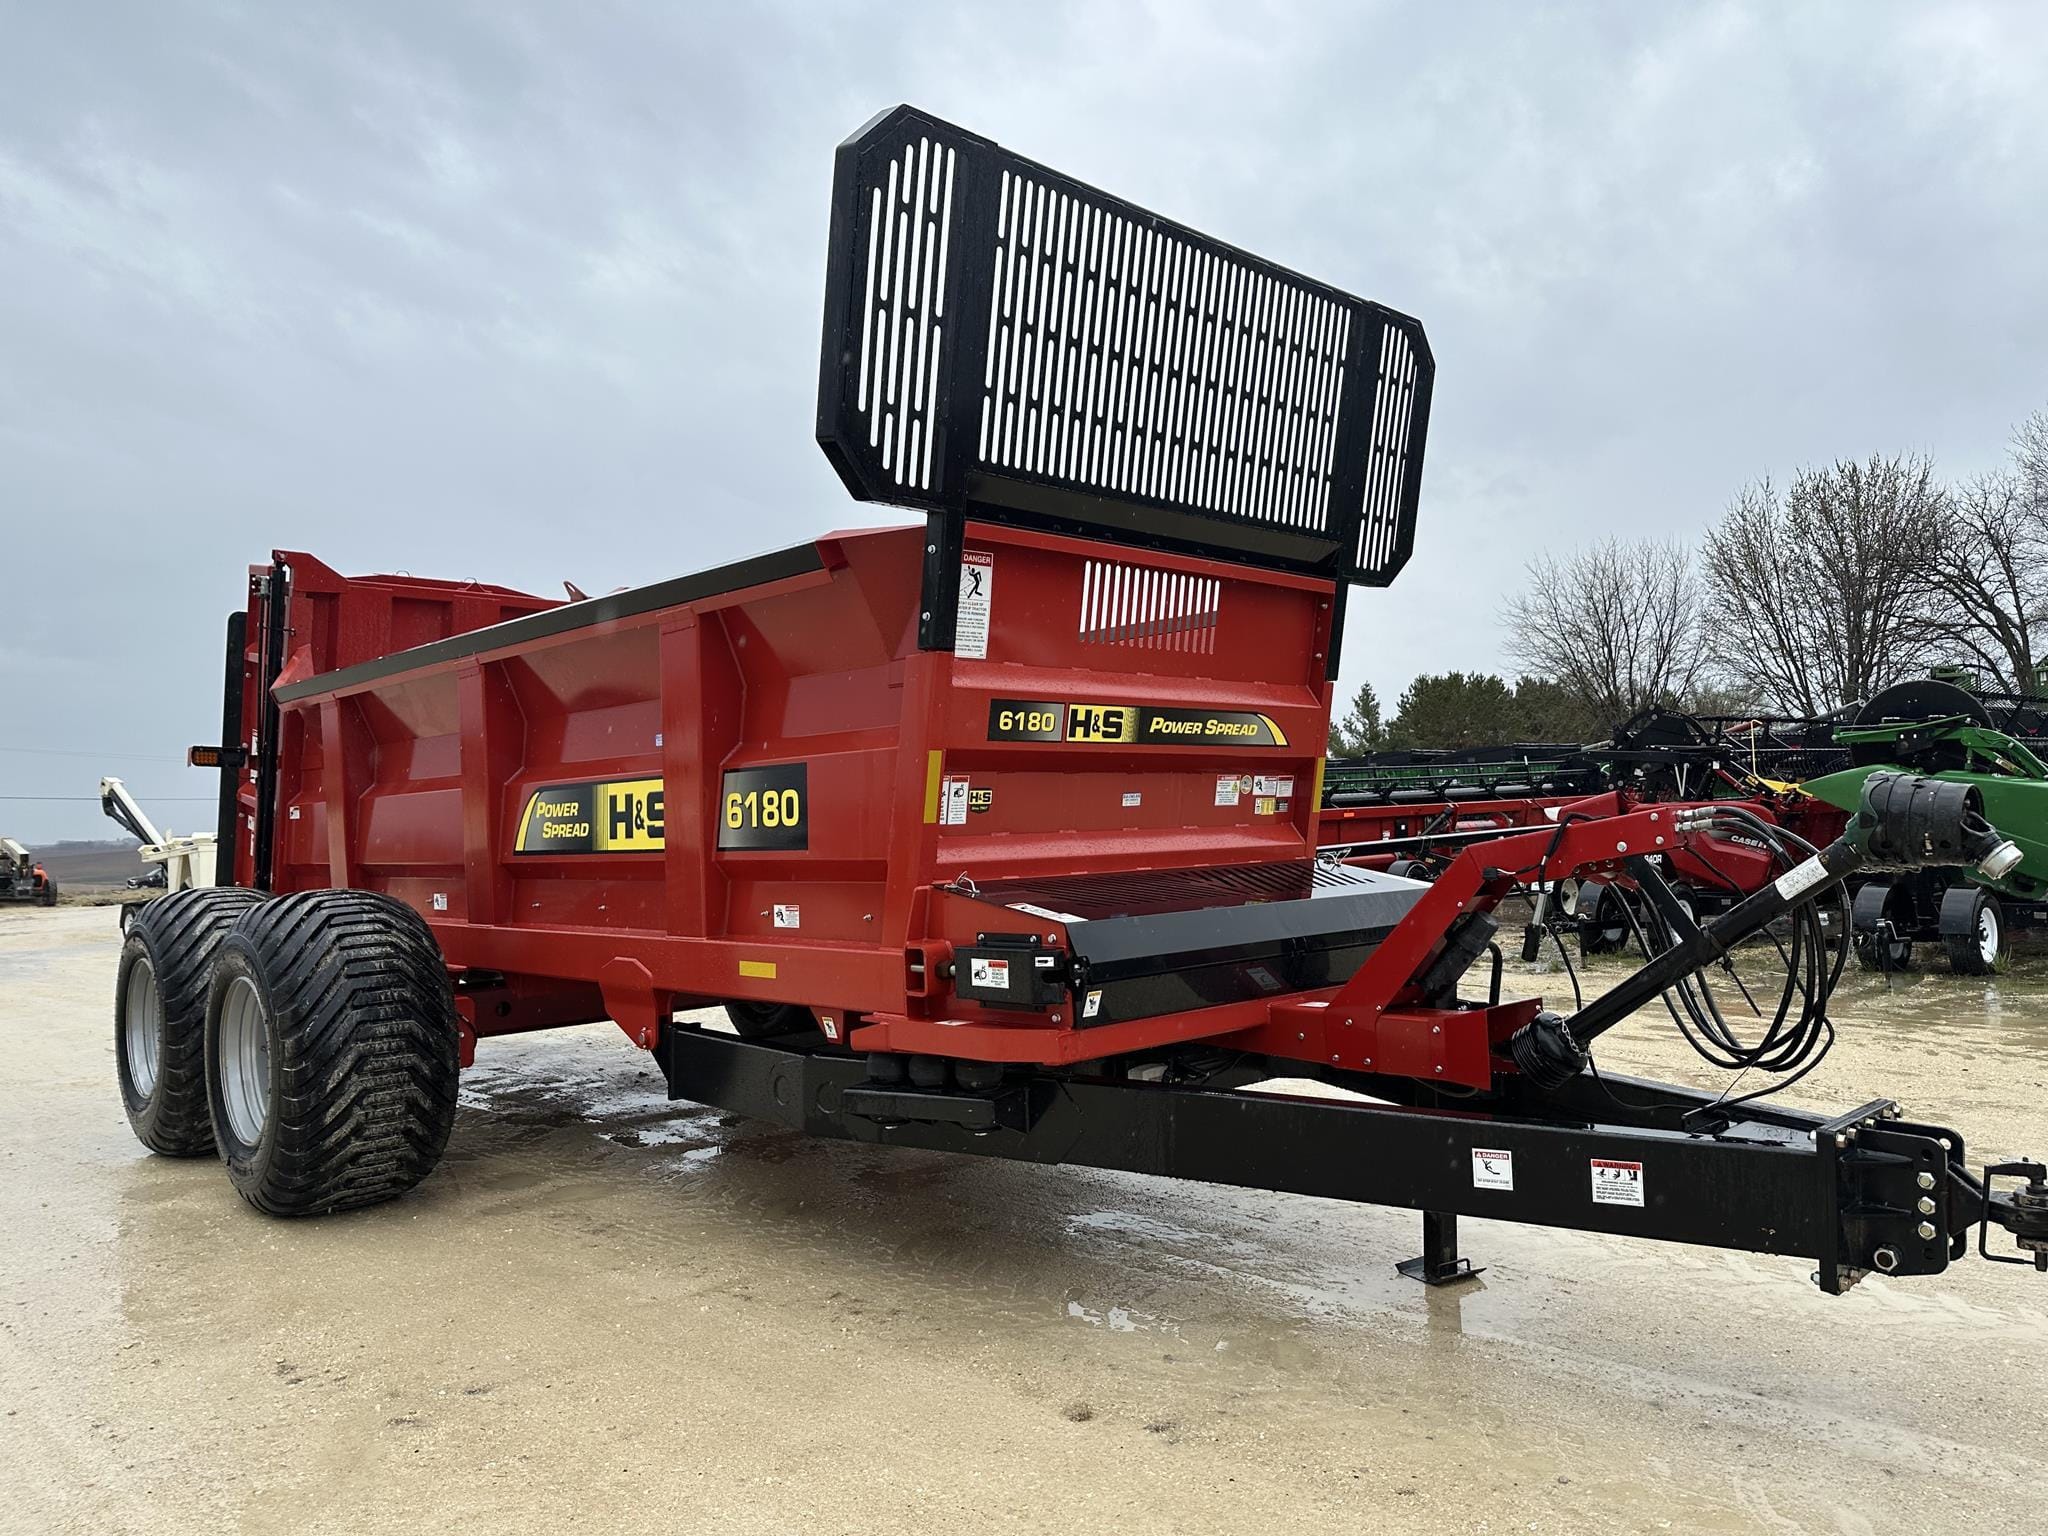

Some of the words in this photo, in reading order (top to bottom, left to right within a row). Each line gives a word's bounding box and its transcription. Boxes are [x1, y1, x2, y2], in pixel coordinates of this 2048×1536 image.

[963, 554, 991, 564] DANGER
[999, 711, 1056, 732] 6180
[1068, 708, 1124, 739] H&S
[1149, 717, 1203, 735] POWER
[1204, 719, 1258, 736] SPREAD
[970, 791, 991, 803] H&S
[536, 802, 579, 818] POWER
[726, 789, 799, 829] 6180
[542, 822, 590, 838] SPREAD
[1731, 835, 1759, 847] CASE
[1602, 1161, 1637, 1170] WARNING
